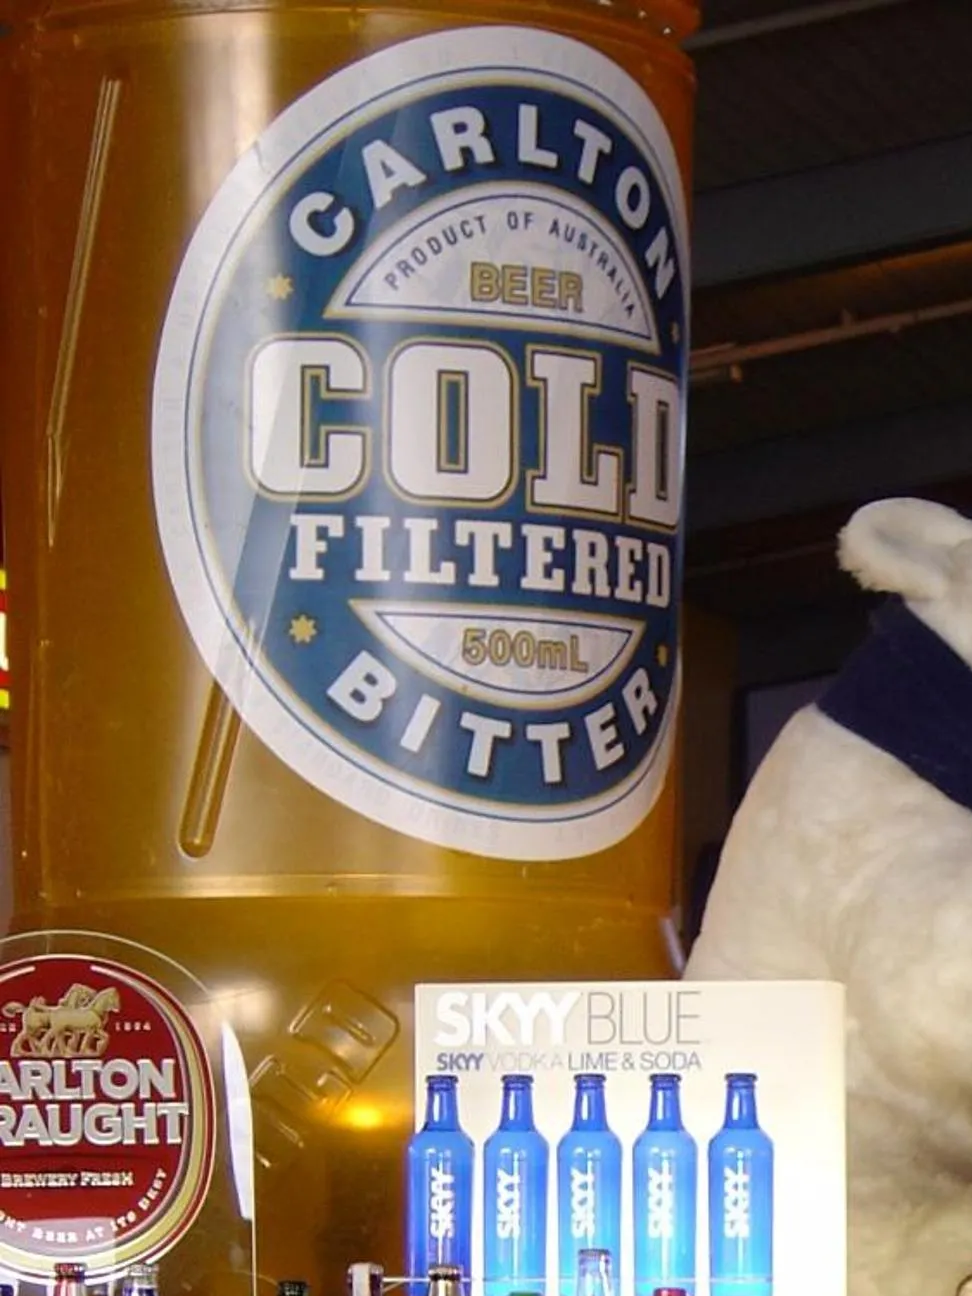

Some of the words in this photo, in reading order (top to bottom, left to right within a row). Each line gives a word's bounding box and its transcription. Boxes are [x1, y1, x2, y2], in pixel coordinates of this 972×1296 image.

[289, 103, 679, 301] CARLTON
[384, 215, 488, 291] PRODUCT
[506, 211, 535, 232] OF
[548, 216, 637, 318] AUSTRALIA
[470, 261, 586, 313] BEER
[244, 333, 683, 530] COLD
[289, 512, 671, 609] FILTERED
[461, 627, 590, 675] 500mL
[326, 649, 660, 784] BITTER
[433, 990, 586, 1048] SKYY
[587, 990, 702, 1046] BLUE
[436, 1051, 485, 1072] SKYY
[486, 1052, 565, 1072] VODKA
[567, 1051, 619, 1072] LIME
[621, 1051, 636, 1071] &
[639, 1051, 702, 1072] SODA
[430, 1163, 456, 1241] SKYY
[496, 1166, 521, 1240] SKYY
[570, 1166, 596, 1240] SKYY
[647, 1166, 674, 1241] SKYY
[723, 1166, 751, 1241] SKYY
